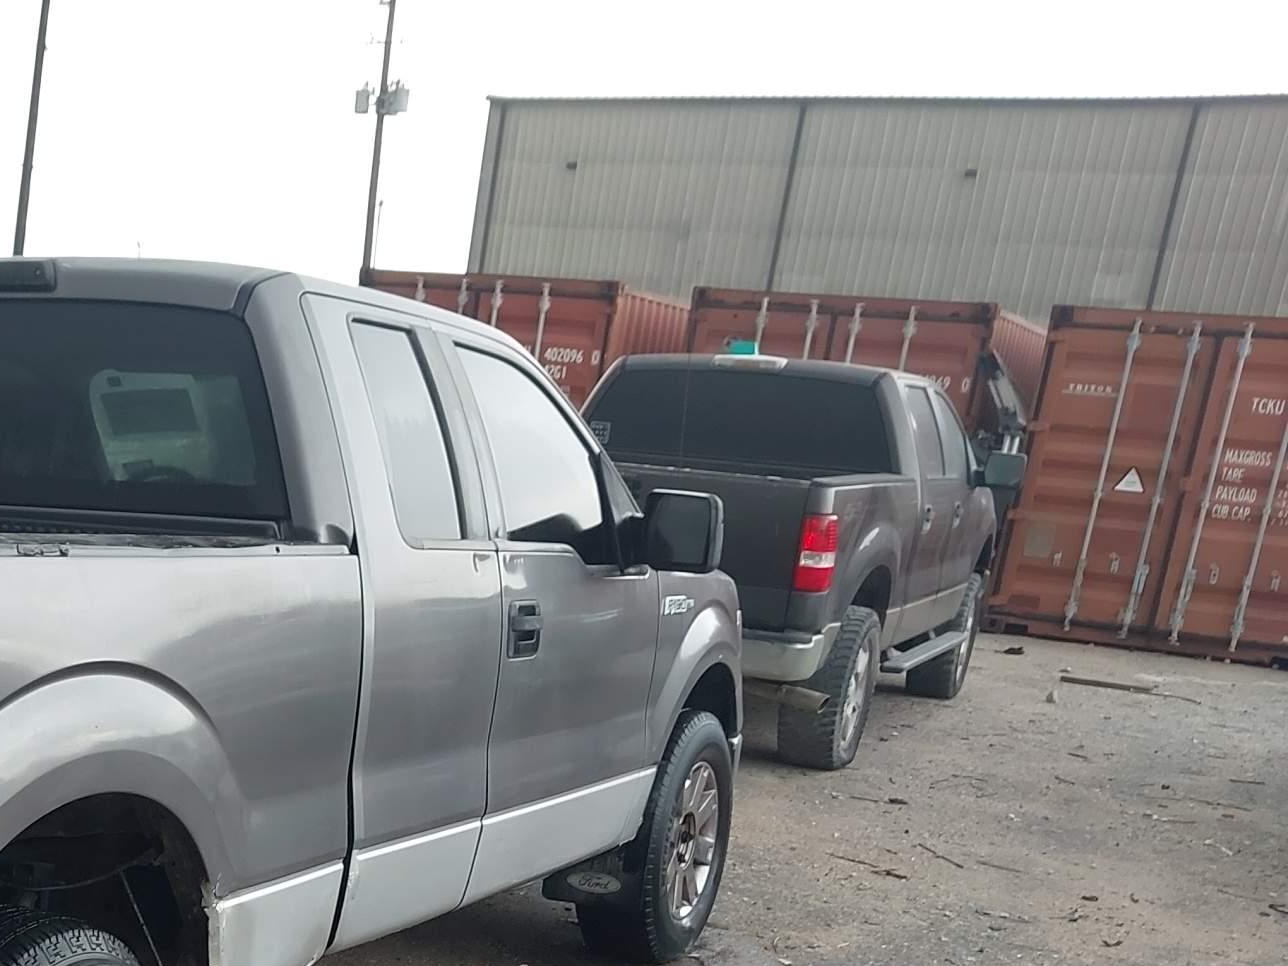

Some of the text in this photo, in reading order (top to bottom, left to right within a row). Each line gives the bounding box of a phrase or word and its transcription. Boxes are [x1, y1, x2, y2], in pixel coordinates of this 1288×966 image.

[544, 347, 584, 364] 402096
[1251, 397, 1286, 416] TCKU
[1221, 466, 1246, 483] TARE
[1215, 485, 1258, 504] PAYLOAD
[1211, 503, 1229, 520] CUB
